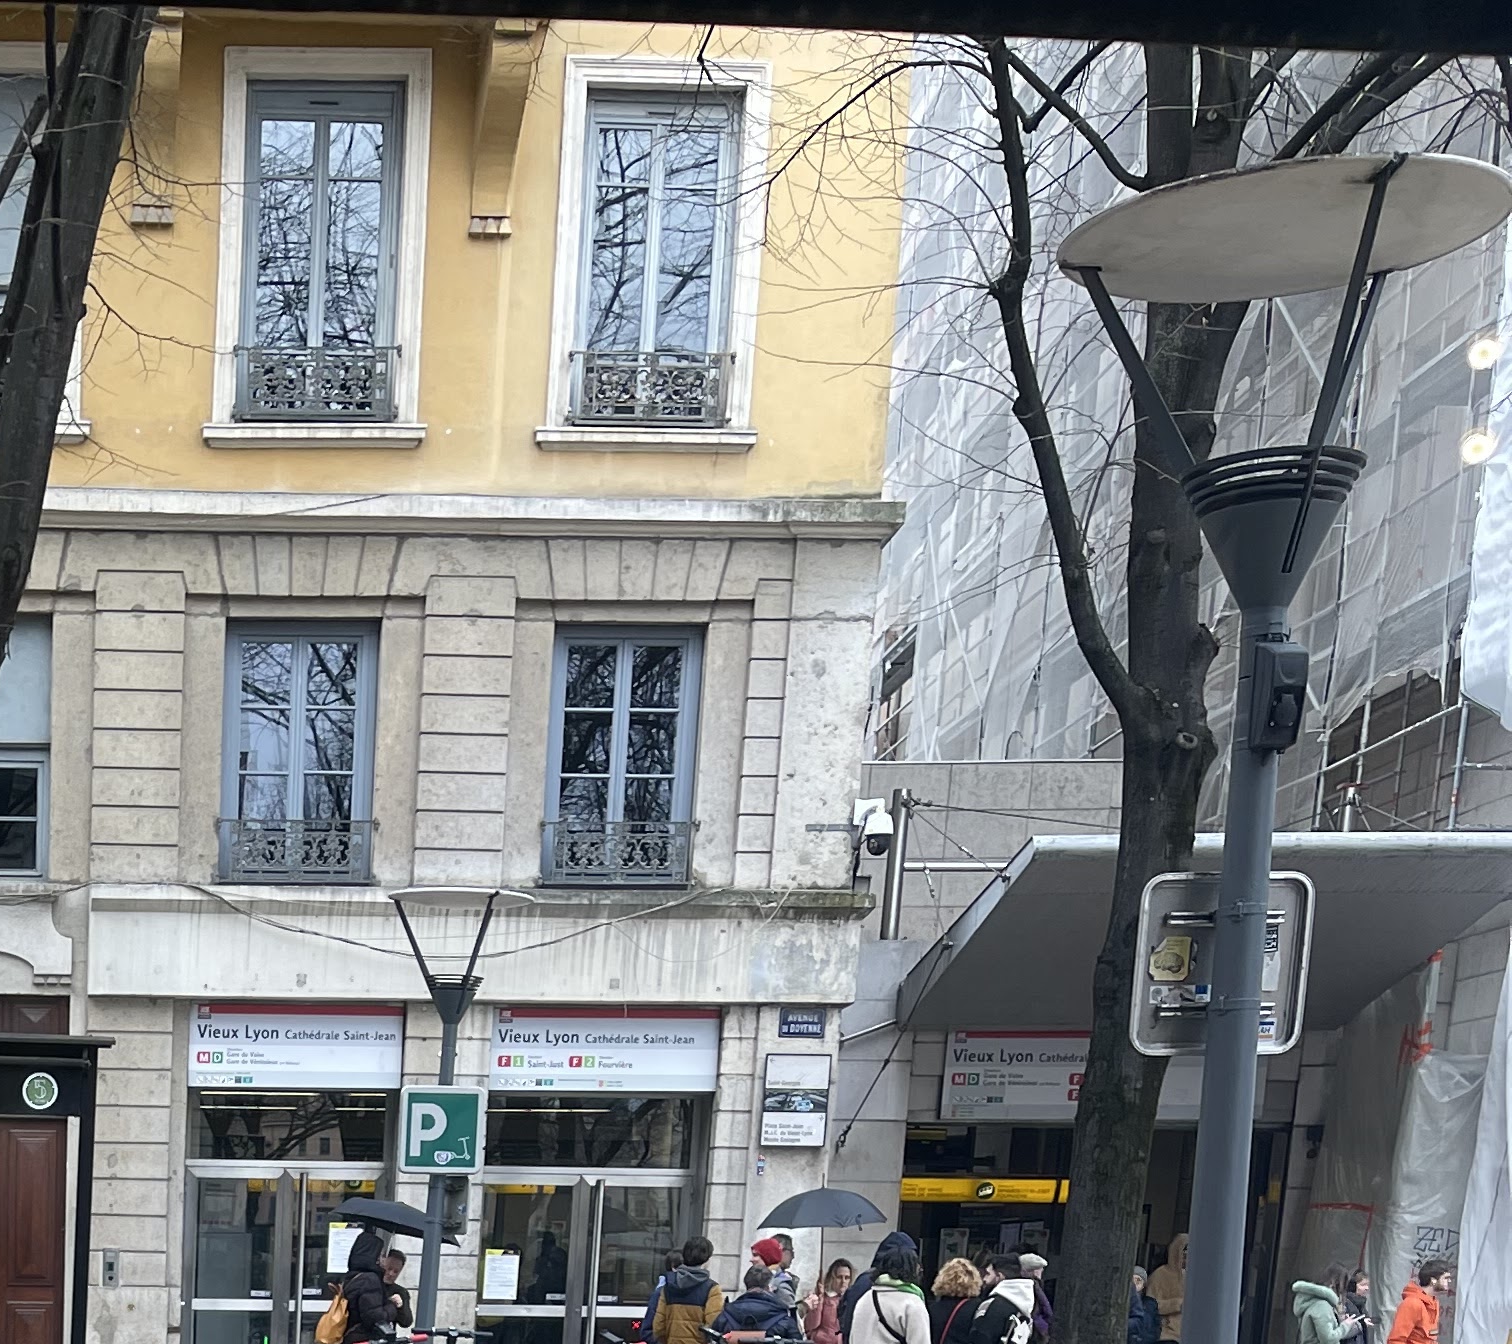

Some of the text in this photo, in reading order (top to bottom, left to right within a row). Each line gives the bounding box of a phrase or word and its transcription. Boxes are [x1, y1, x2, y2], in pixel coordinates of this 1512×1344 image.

[197, 1023, 397, 1043] Vieux Lyon Cathédrale Saint-Jean
[497, 1028, 695, 1047] Vieux Lyon Cathédrale Saint-Jean
[952, 1048, 995, 1064] Vieux
[999, 1049, 1034, 1066] Lyon
[409, 1102, 448, 1157] P
